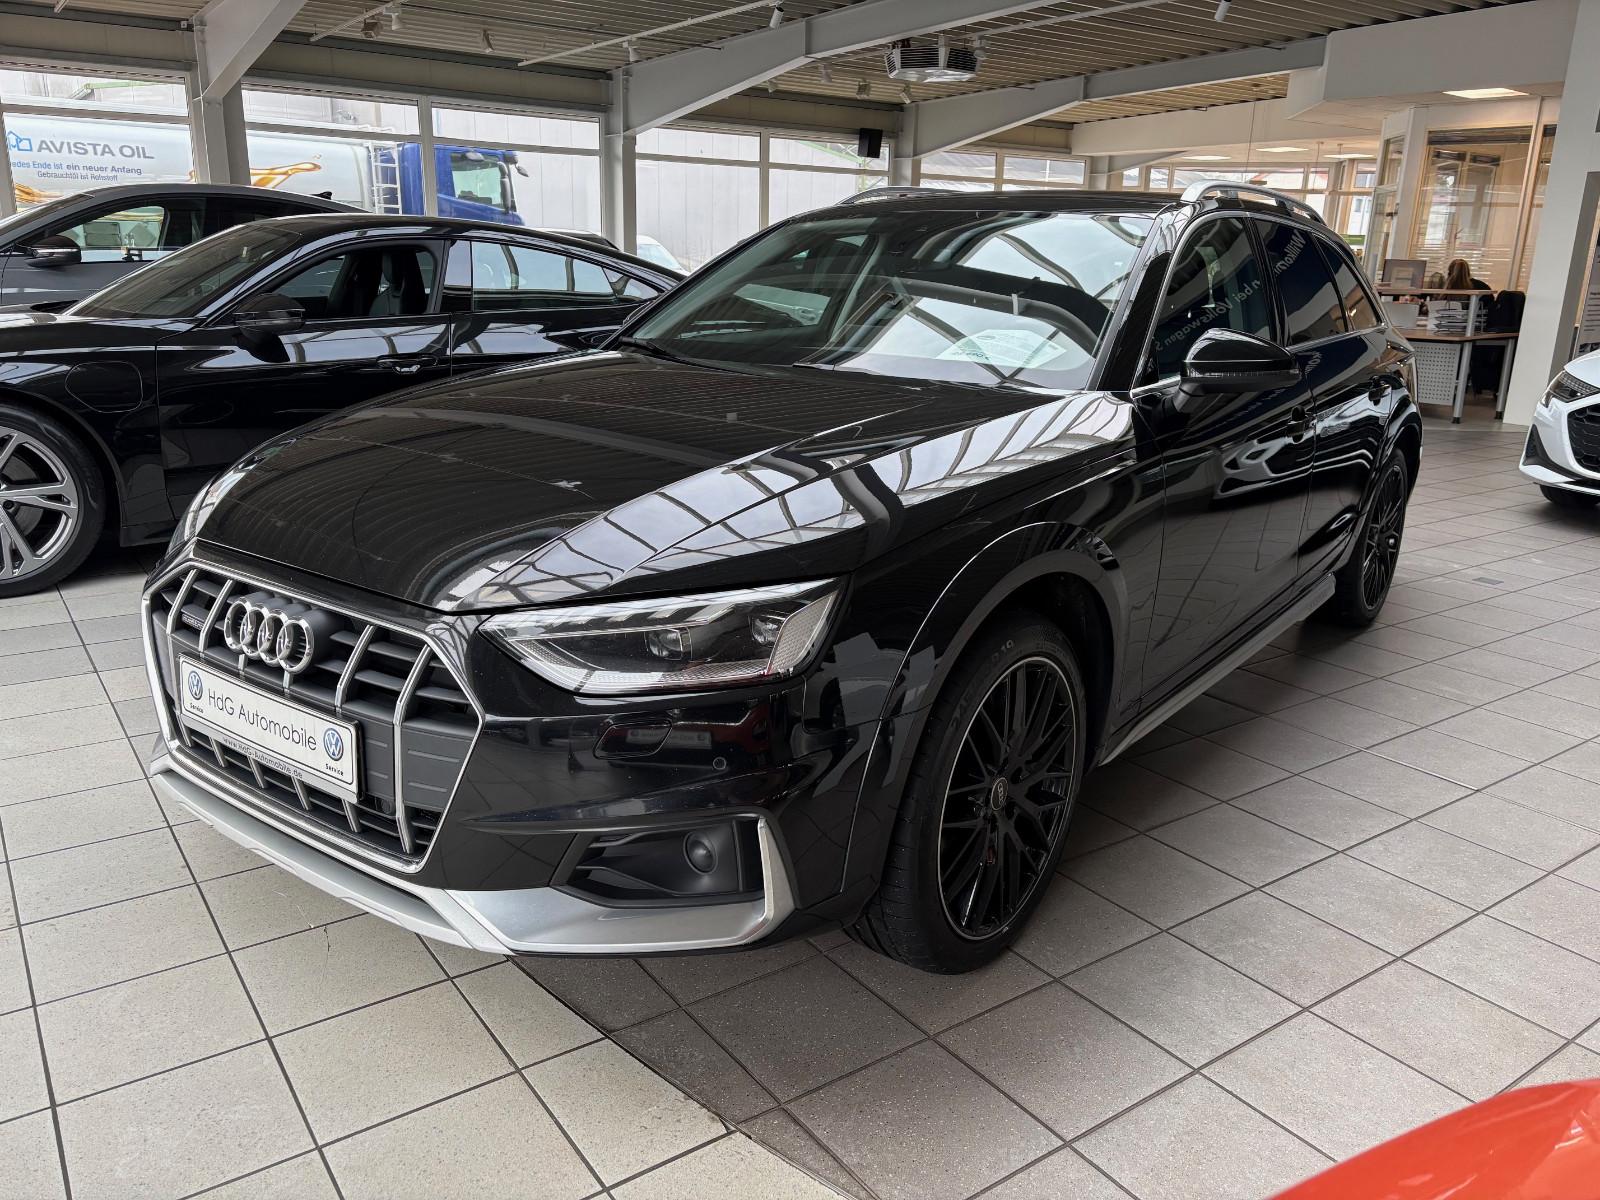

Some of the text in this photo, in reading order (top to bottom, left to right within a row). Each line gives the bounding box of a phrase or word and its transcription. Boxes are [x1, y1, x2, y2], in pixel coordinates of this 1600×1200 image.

[37, 139, 155, 160] AVISTA OIL
[32, 160, 52, 170] Ende
[53, 161, 63, 170] ist
[66, 163, 80, 171] ein
[82, 164, 109, 172] neuer
[110, 165, 143, 176] Anfang
[90, 173, 119, 182] Rohstoff
[208, 687, 317, 751] HdG Automobile
[325, 763, 344, 777] Service
